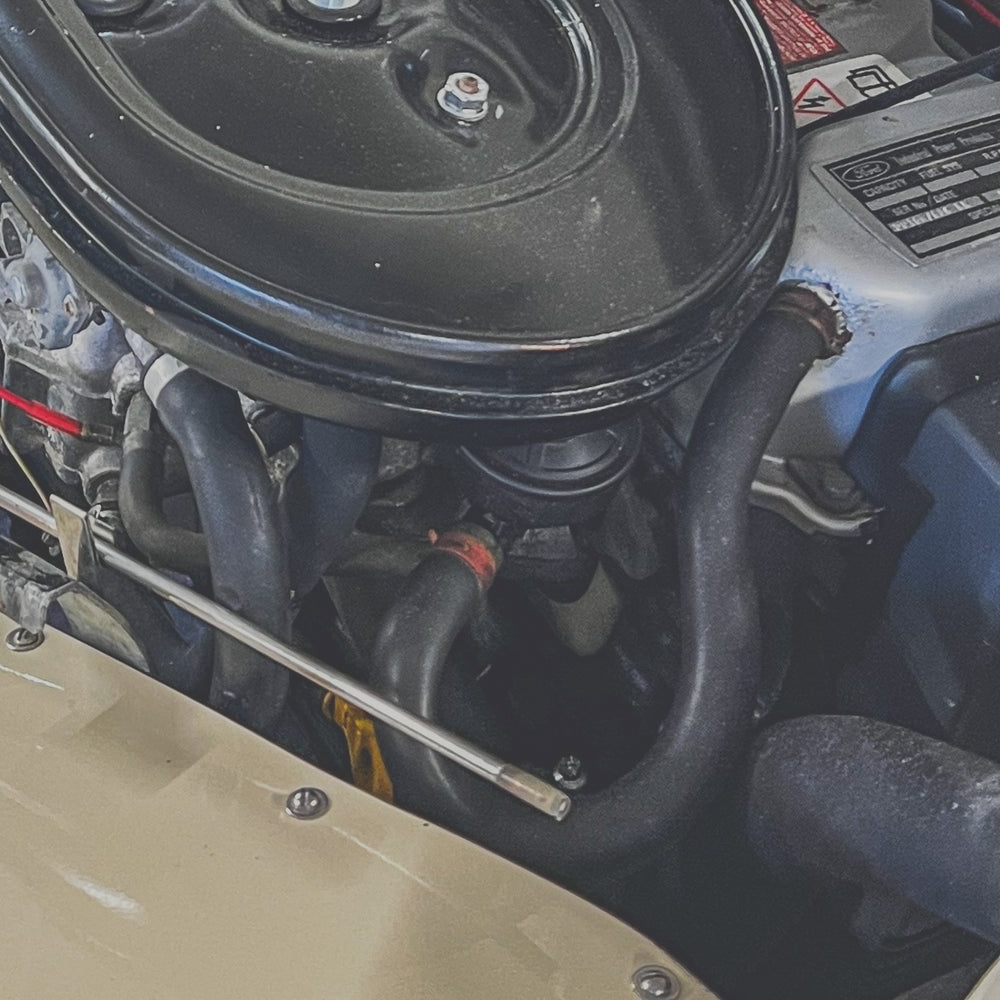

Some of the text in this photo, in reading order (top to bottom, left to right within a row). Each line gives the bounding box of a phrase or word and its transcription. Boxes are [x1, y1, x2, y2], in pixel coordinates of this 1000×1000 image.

[853, 163, 883, 179] Ford
[863, 179, 908, 197] CAPACITY
[918, 166, 944, 179] FUEL
[933, 190, 959, 203] DATE
